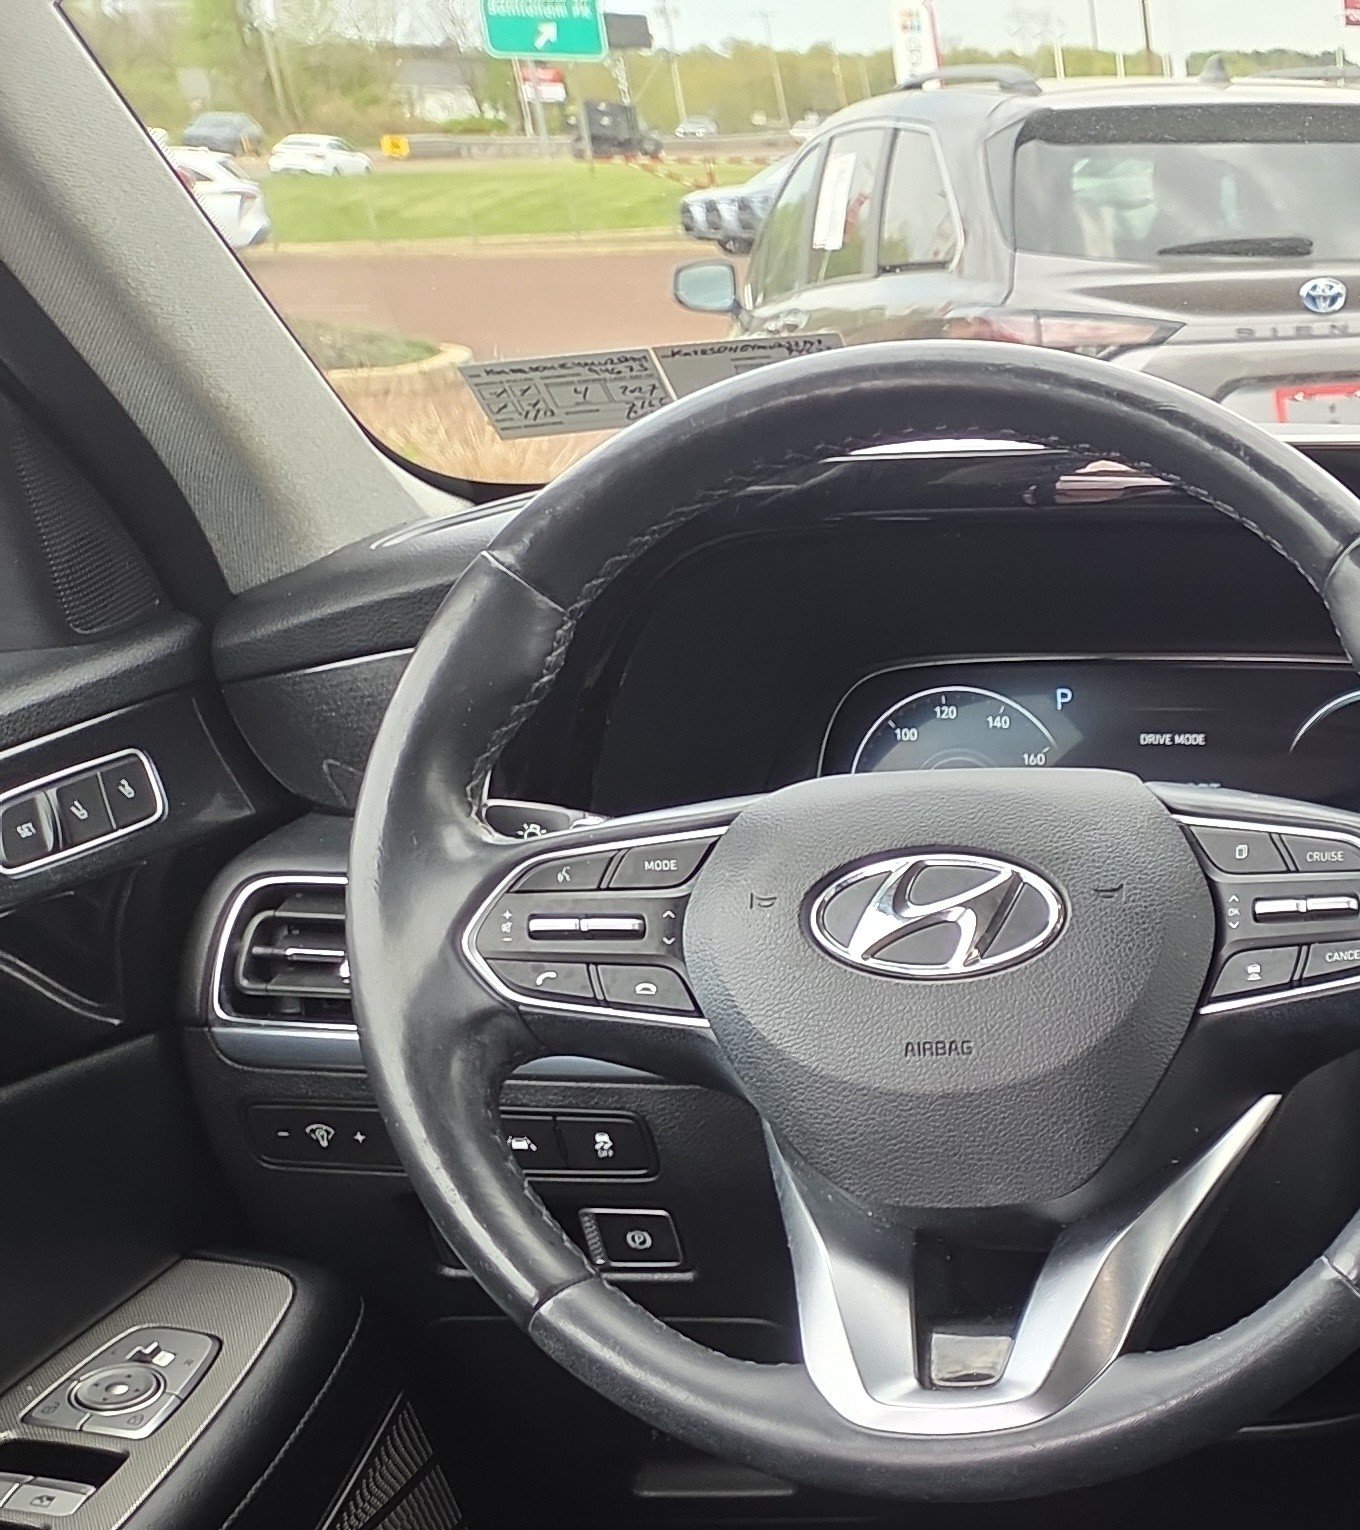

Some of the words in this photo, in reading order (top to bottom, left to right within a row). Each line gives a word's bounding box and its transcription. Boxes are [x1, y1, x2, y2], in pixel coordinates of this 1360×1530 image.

[1056, 689, 1073, 710] P
[934, 706, 958, 719] 120
[987, 715, 1010, 729] 140
[895, 728, 918, 741] 100
[1140, 733, 1173, 746] DRIVE
[1174, 734, 1206, 746] MODE
[1023, 753, 1046, 766] 160
[1306, 851, 1345, 863] CRUISE
[644, 858, 678, 872] MODE
[1228, 907, 1240, 917] OK
[904, 1040, 974, 1057] AIRBAG
